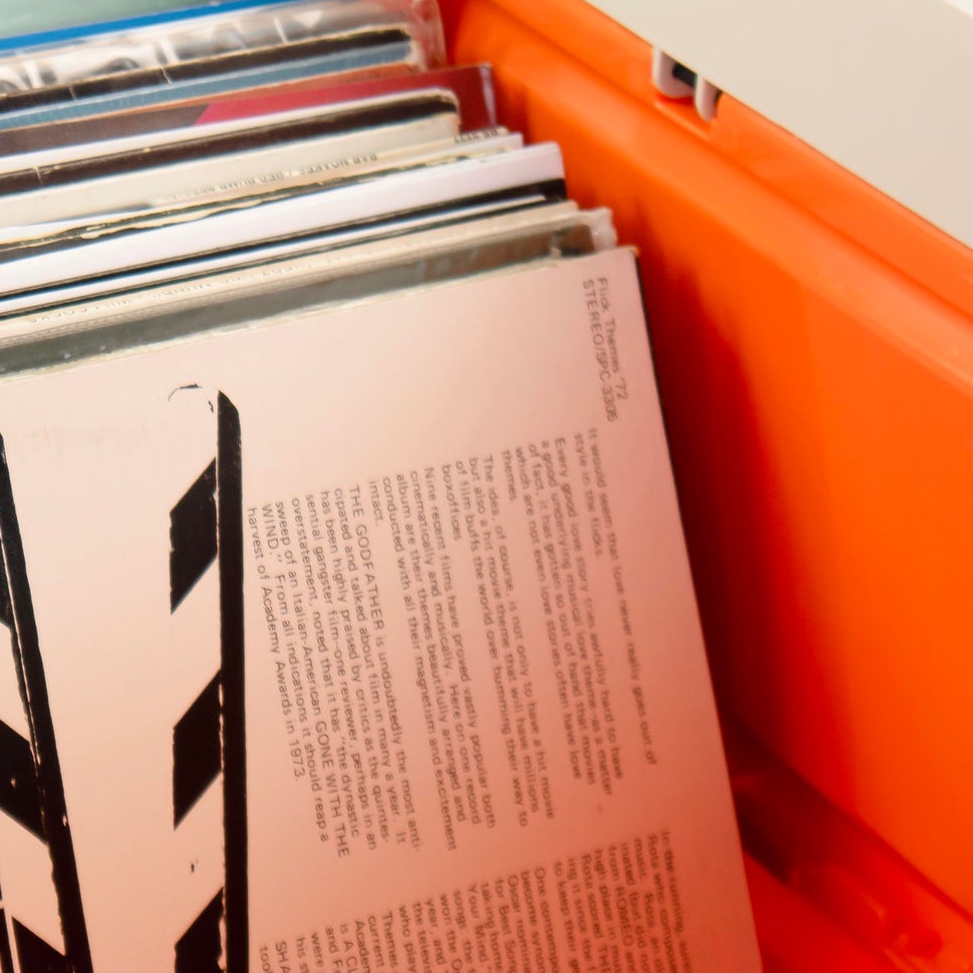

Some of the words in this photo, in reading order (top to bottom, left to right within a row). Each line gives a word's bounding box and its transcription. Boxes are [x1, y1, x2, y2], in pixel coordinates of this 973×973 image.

[604, 317, 621, 374] Themes
[305, 494, 323, 540] sential
[320, 490, 331, 515] has
[333, 487, 353, 540] cipated
[348, 483, 364, 518] THE
[247, 506, 264, 560] harvest
[275, 501, 290, 545] sweep
[324, 518, 338, 553] been
[256, 564, 270, 579] of
[284, 549, 297, 564] of
[312, 545, 333, 604] gangster
[343, 544, 359, 572] and
[274, 574, 288, 614] From
[287, 570, 298, 587] an
[331, 557, 347, 602] highly
[355, 523, 384, 630] GODFATHER
[350, 576, 367, 622] talked
[261, 586, 280, 653] Academy
[281, 619, 294, 636] all
[312, 611, 328, 652] noted
[338, 608, 359, 659] praised
[292, 592, 321, 715] Italian-American
[358, 626, 374, 669] about
[375, 636, 384, 647] is
[274, 660, 293, 715] Awards
[286, 642, 307, 723] indications
[320, 657, 333, 687] that
[350, 664, 361, 682] by
[367, 672, 380, 704] film
[327, 692, 336, 703] it
[355, 688, 370, 733] critics
[374, 708, 383, 723] in
[377, 651, 403, 744] undoubtedly
[285, 719, 295, 734] in
[301, 727, 311, 737] it
[330, 707, 340, 732] has
[314, 720, 334, 768] GONE
[363, 737, 374, 752] as
[377, 727, 391, 767] many
[395, 749, 407, 773] the
[303, 742, 322, 791] should
[349, 752, 369, 810] perhaps
[367, 755, 379, 779] the
[314, 797, 326, 829] reap
[324, 773, 342, 817] WITH
[340, 774, 359, 837] dynastic
[372, 784, 389, 841] quintes-
[401, 778, 415, 815] most
[362, 813, 372, 828] in
[395, 831, 407, 843] It
[407, 819, 420, 851] anti-
[334, 822, 349, 857] THE
[365, 832, 376, 850] an
